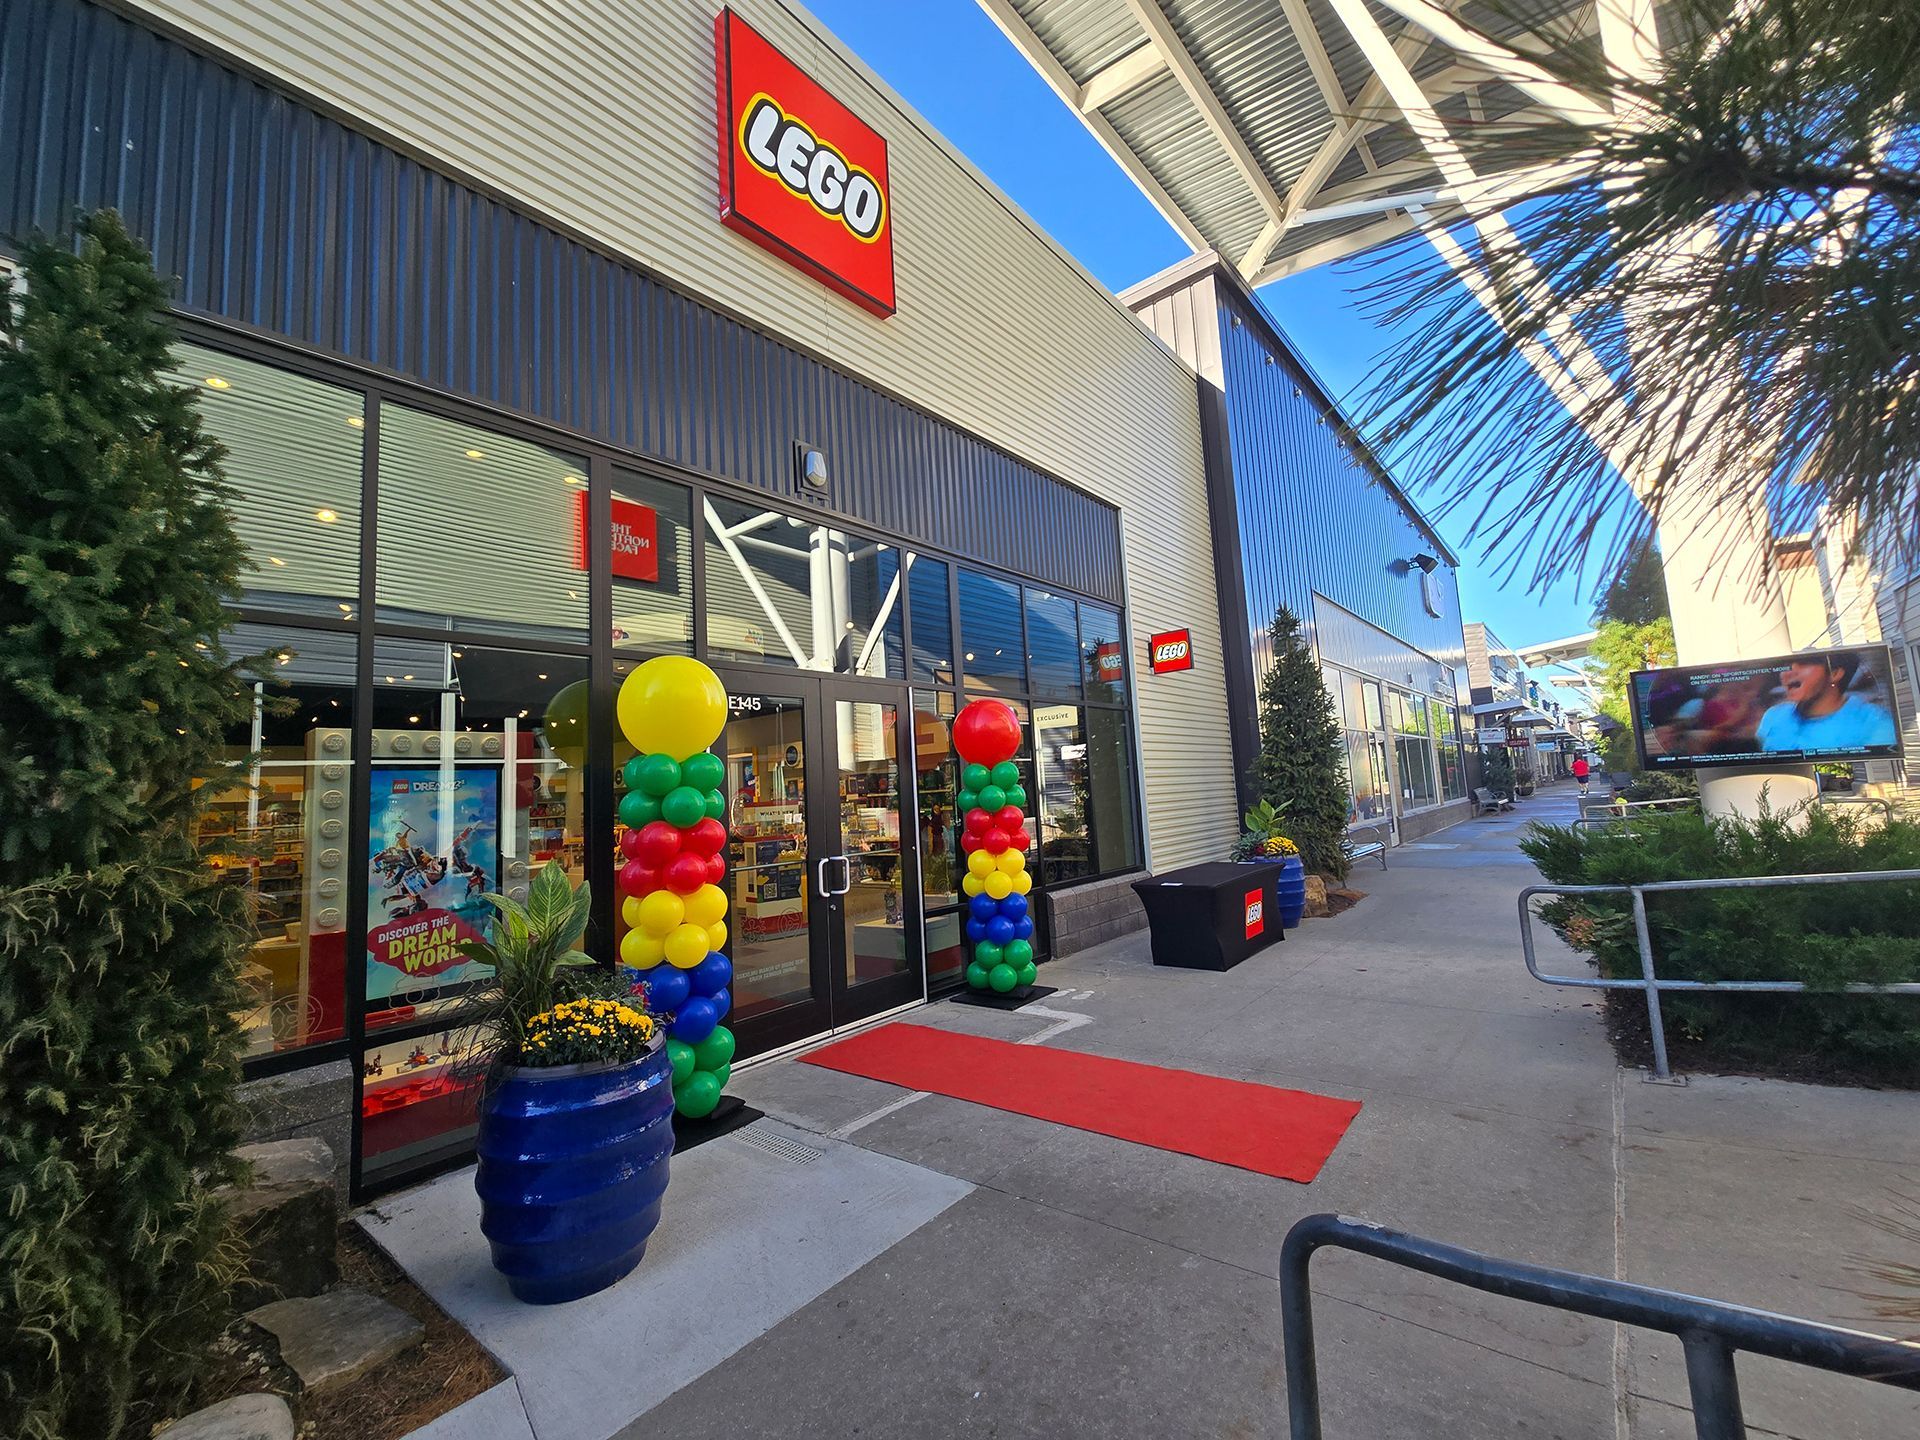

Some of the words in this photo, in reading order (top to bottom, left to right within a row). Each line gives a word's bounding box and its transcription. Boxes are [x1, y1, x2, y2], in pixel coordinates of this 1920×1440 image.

[744, 101, 881, 236] LEGO
[1156, 642, 1187, 661] LEGO
[728, 695, 761, 711] E145
[393, 783, 409, 791] LEGO
[1247, 902, 1262, 924] LEGO
[378, 921, 428, 944] DISCOVER
[431, 915, 449, 928] THE
[388, 923, 457, 960] DREAM
[403, 938, 473, 973] WORL
